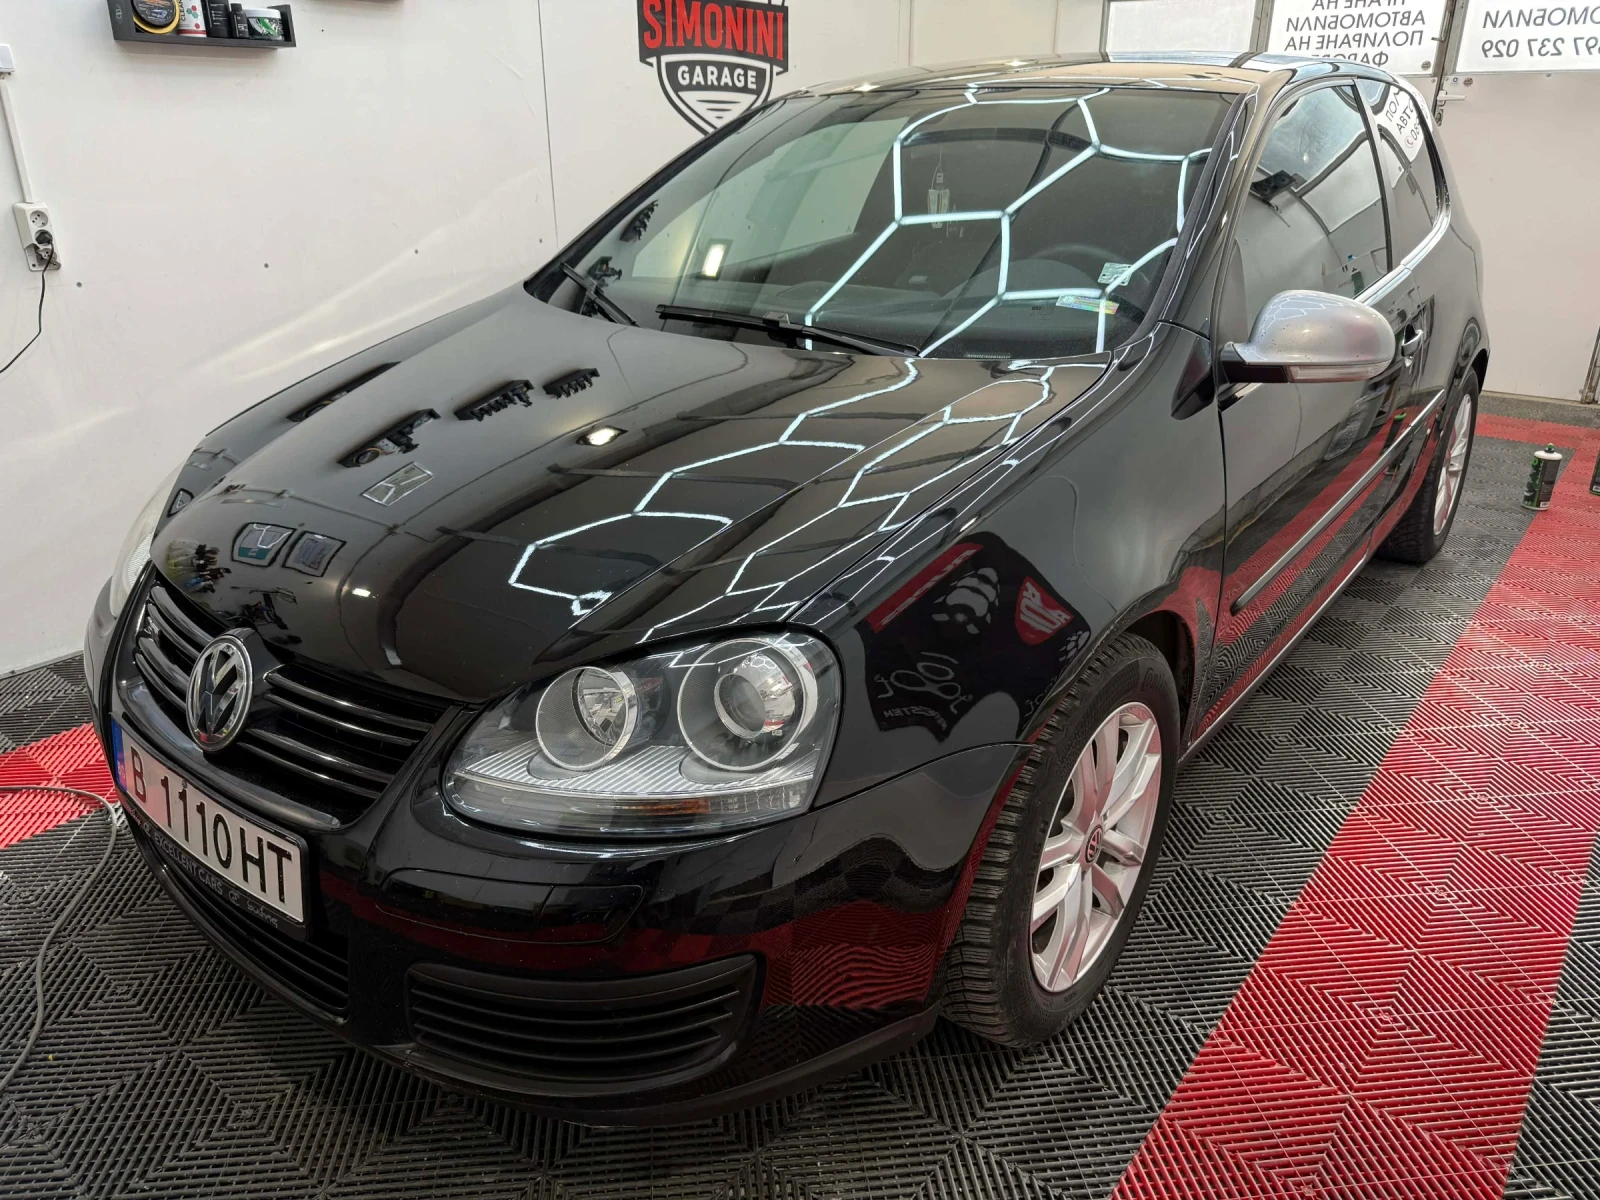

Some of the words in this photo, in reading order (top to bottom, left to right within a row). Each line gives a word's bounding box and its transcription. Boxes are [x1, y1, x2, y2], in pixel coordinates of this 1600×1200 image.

[643, 0, 784, 61] SIMONINI
[677, 65, 757, 90] GARAGE
[130, 746, 147, 803] B
[160, 775, 233, 869] 1110
[239, 826, 293, 904] HT
[154, 831, 198, 876] EXCELLENT
[198, 868, 223, 895] CARS
